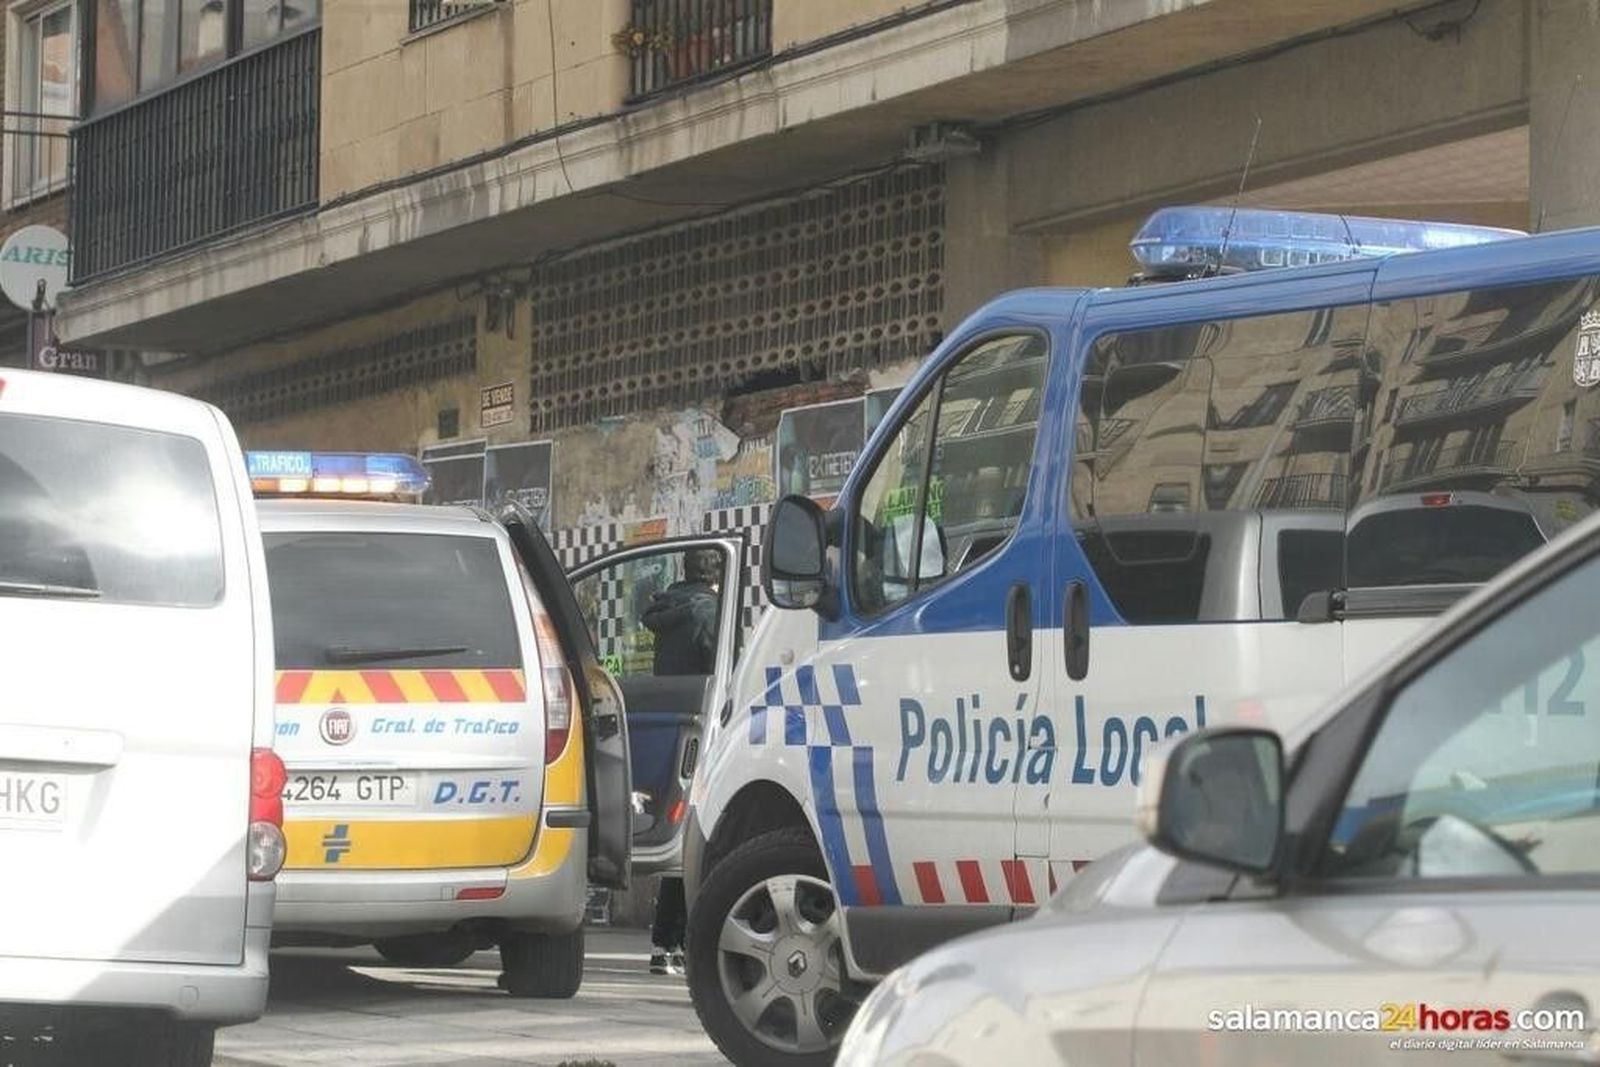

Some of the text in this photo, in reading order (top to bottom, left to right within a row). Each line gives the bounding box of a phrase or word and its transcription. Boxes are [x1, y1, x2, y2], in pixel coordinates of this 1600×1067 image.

[38, 345, 97, 370] Gran
[255, 454, 305, 473] TRAFICO
[370, 717, 416, 734] Gral.
[423, 718, 446, 734] de
[895, 692, 1207, 787] Policía Loc
[356, 775, 405, 801] GTP
[432, 780, 521, 804] D.G.T.
